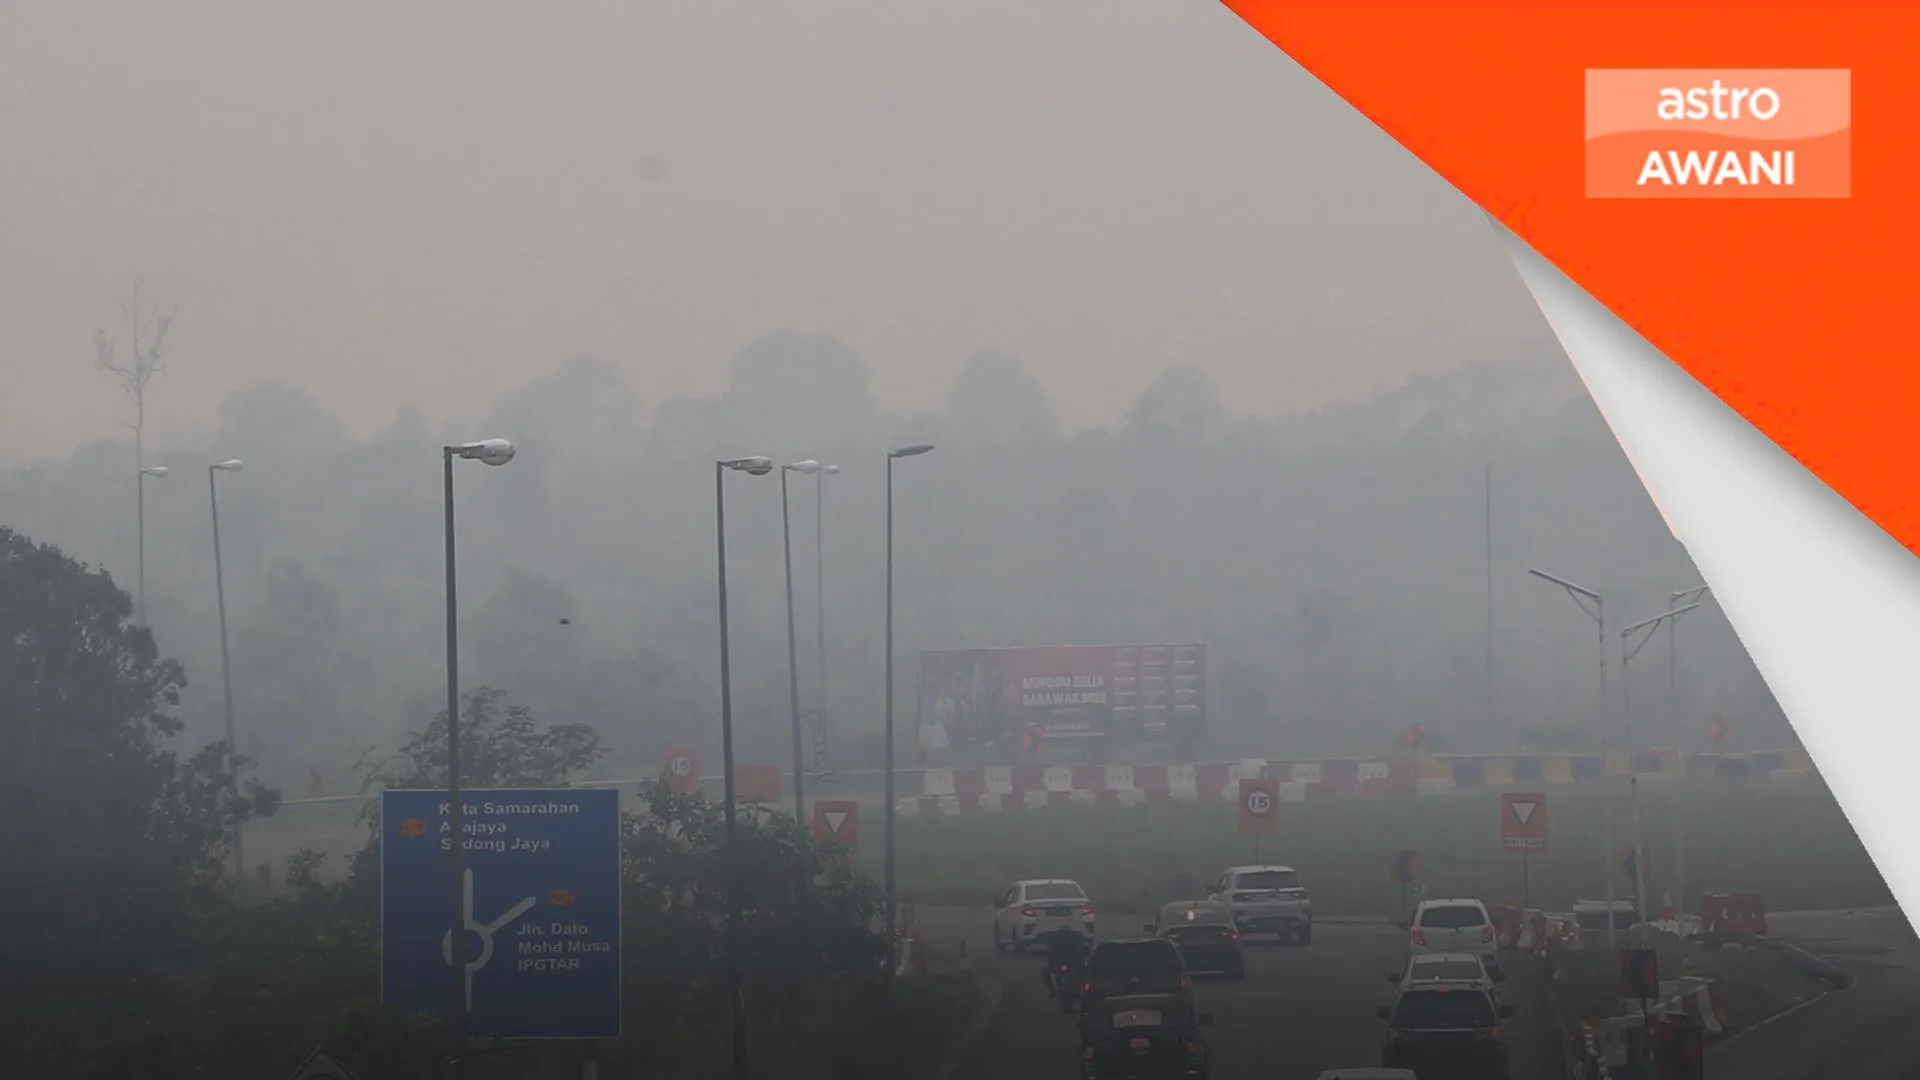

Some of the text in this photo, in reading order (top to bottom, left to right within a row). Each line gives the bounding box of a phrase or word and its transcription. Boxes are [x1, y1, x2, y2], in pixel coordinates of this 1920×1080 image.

[438, 801, 579, 815] Kta Samarahan
[1250, 796, 1269, 809] 15
[439, 820, 507, 836] Aajaya
[440, 837, 550, 853] Sdong Jaya
[517, 922, 588, 935] Jln. Dato
[518, 940, 610, 954] Mohd Musa
[518, 958, 581, 971] IPGTAR
